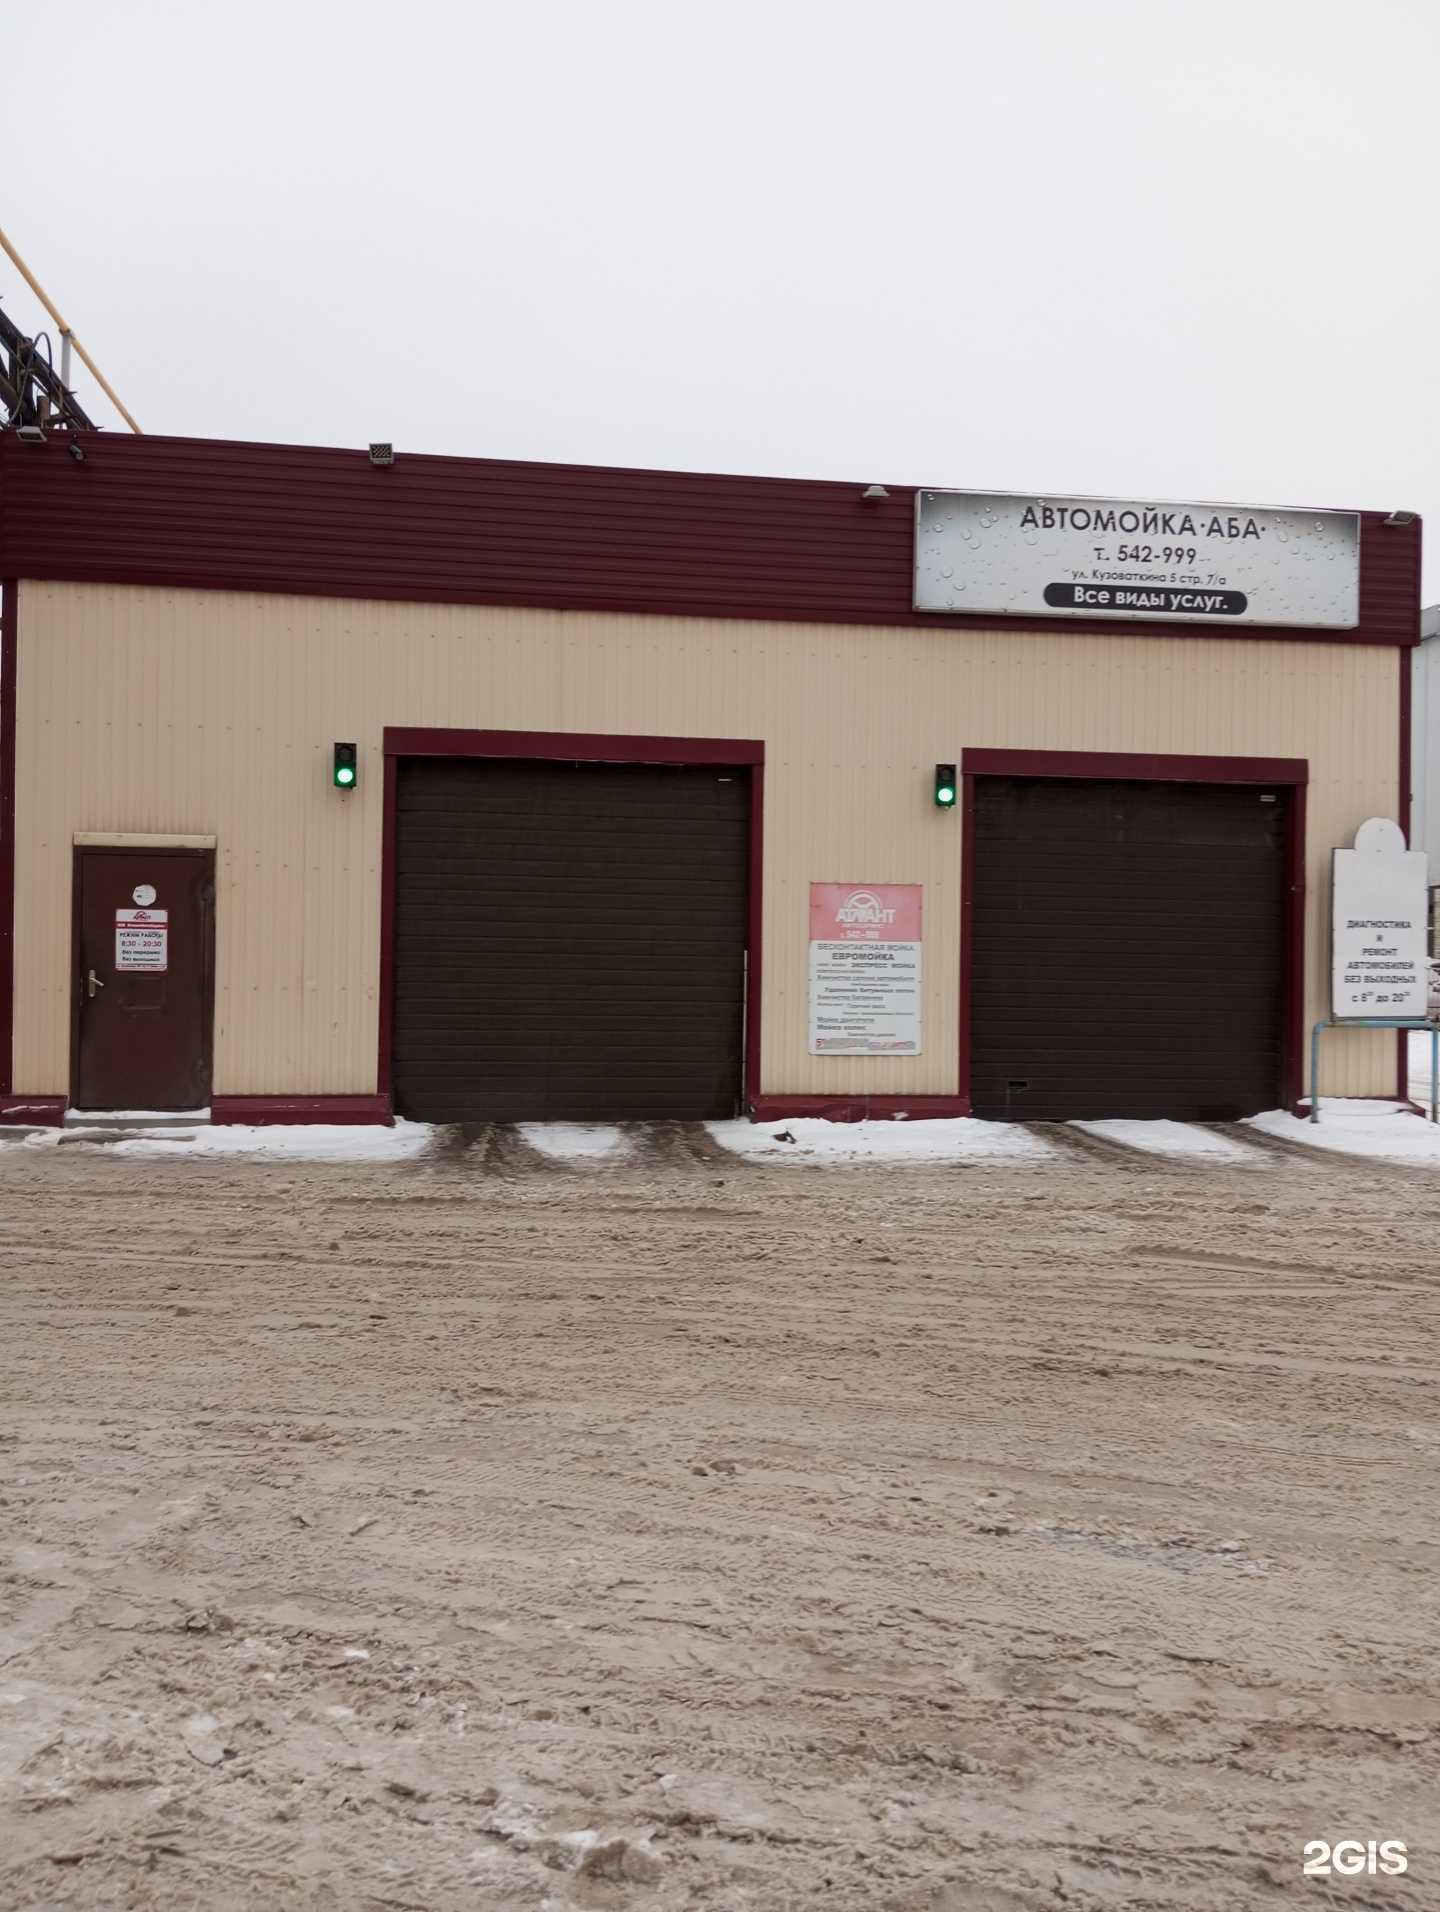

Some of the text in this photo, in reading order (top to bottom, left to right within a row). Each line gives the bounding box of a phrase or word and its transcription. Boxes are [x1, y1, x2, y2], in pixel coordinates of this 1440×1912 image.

[1020, 506, 1197, 537] АВТОМОЙКА
[1117, 544, 1197, 565] 542-999
[1092, 569, 1167, 583] Кузоваткина
[1073, 585, 1229, 612] Все виды услуг.
[1346, 920, 1412, 929] ДИАГНОСТИКА
[1362, 947, 1399, 956] РЕМОНТ
[1346, 960, 1415, 970] АВТОМОБИЛЕЙ
[1344, 975, 1417, 984] БЕЗ ВЫХОДНЫХ
